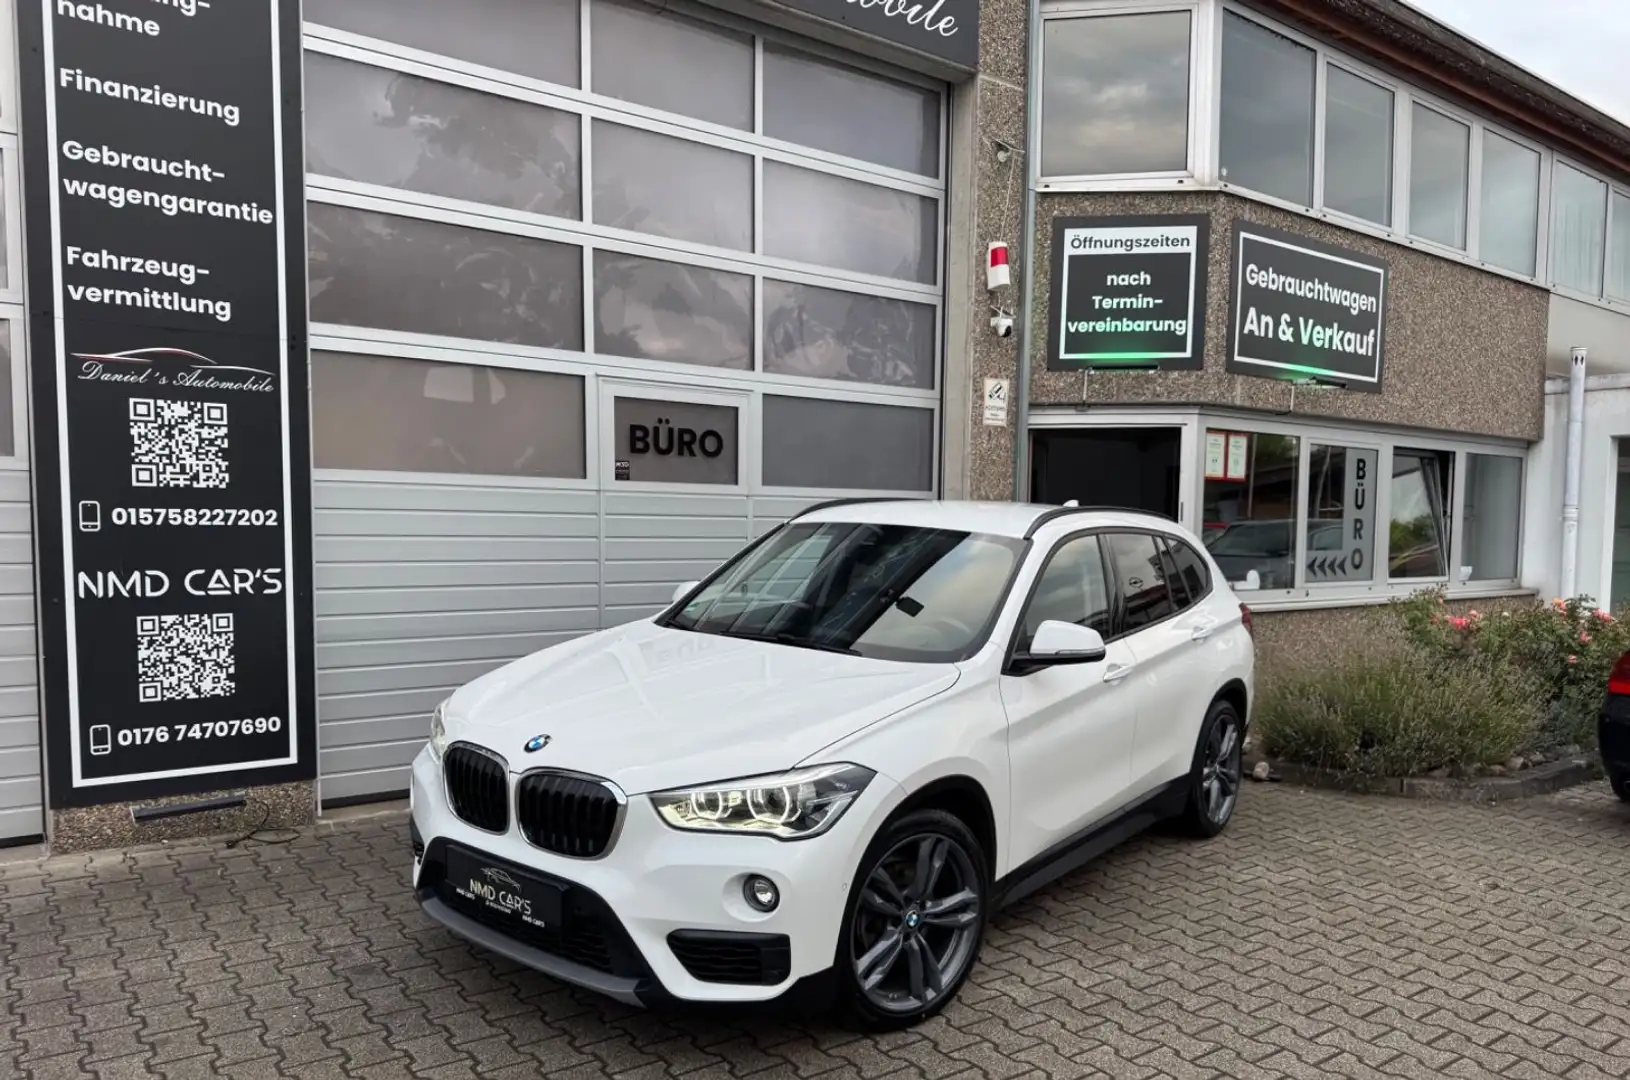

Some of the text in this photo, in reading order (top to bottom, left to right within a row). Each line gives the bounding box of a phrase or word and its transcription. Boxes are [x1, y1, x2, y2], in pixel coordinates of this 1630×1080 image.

[57, 0, 161, 36] nahme
[60, 67, 240, 126] Finanzierung
[62, 140, 225, 182] Gebraucht-
[63, 178, 273, 224] wagengarantie
[1070, 234, 1190, 252] Öffnungszeiten
[67, 246, 210, 285] Fahrzeug-
[1106, 271, 1151, 286] nach
[67, 284, 232, 322] vermittlung
[1092, 293, 1163, 309] Termin-
[1245, 263, 1377, 315] Gebrauchtwagen
[1067, 317, 1187, 335] vereinbarung
[1243, 307, 1376, 357] An & Verkauf
[173, 369, 275, 392] Automobile
[629, 417, 723, 458] BÜRO
[111, 508, 278, 526] 015758227202
[1351, 458, 1367, 570] BÜRO
[78, 568, 282, 599] NMD CAR'S
[117, 716, 281, 746] 0176 74707690
[470, 878, 496, 900] NMD
[499, 891, 532, 915] CAR'S
